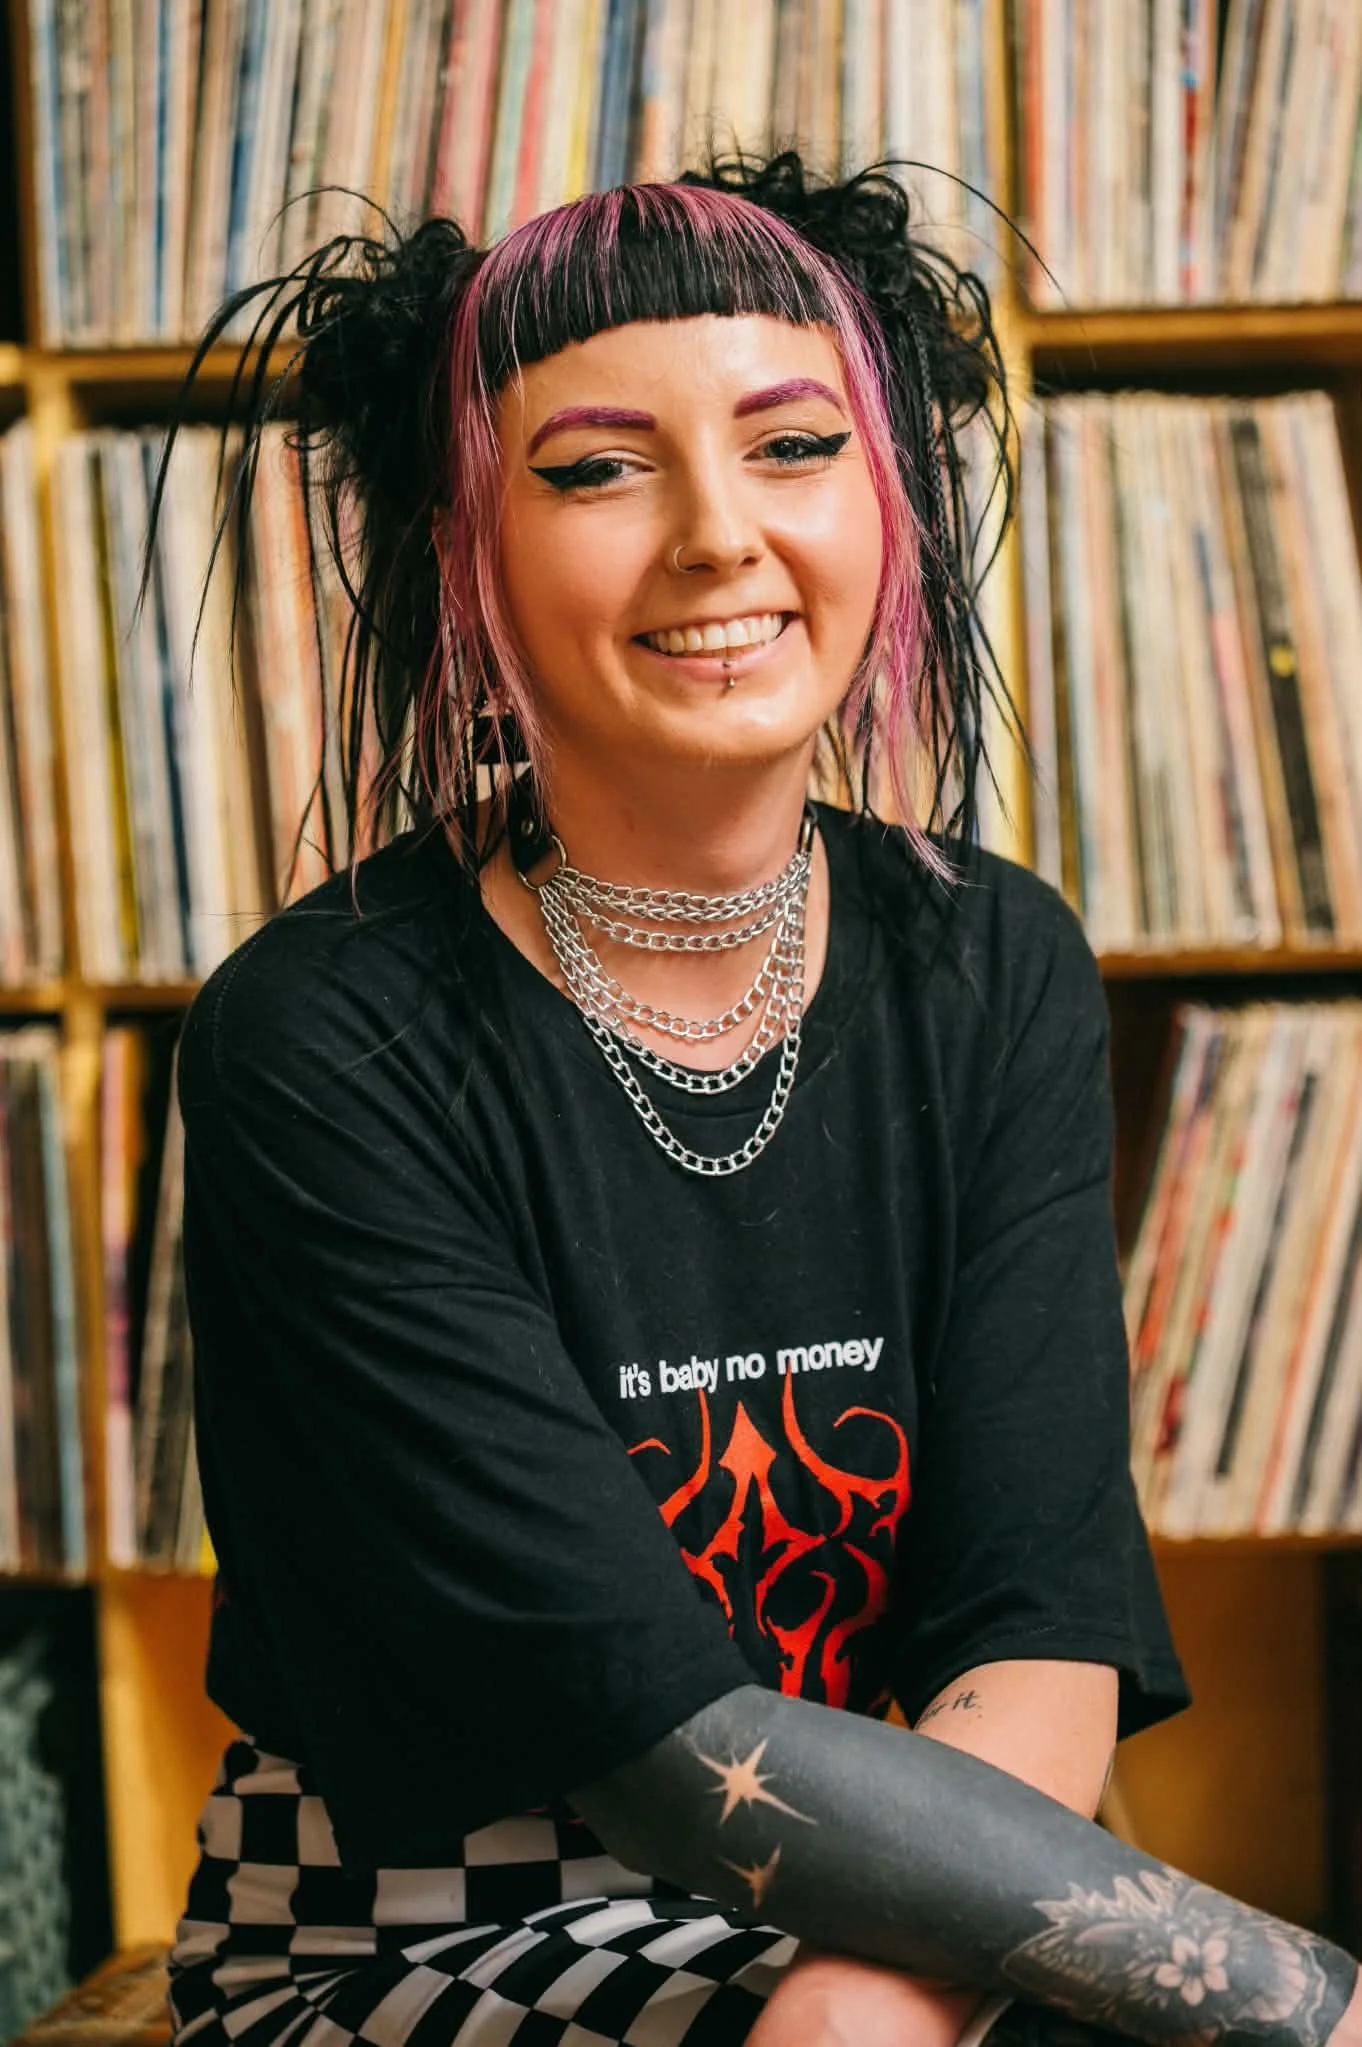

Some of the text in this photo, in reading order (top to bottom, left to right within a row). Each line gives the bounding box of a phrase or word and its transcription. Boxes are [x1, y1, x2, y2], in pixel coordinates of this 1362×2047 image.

[619, 1336, 885, 1399] it's baby no money
